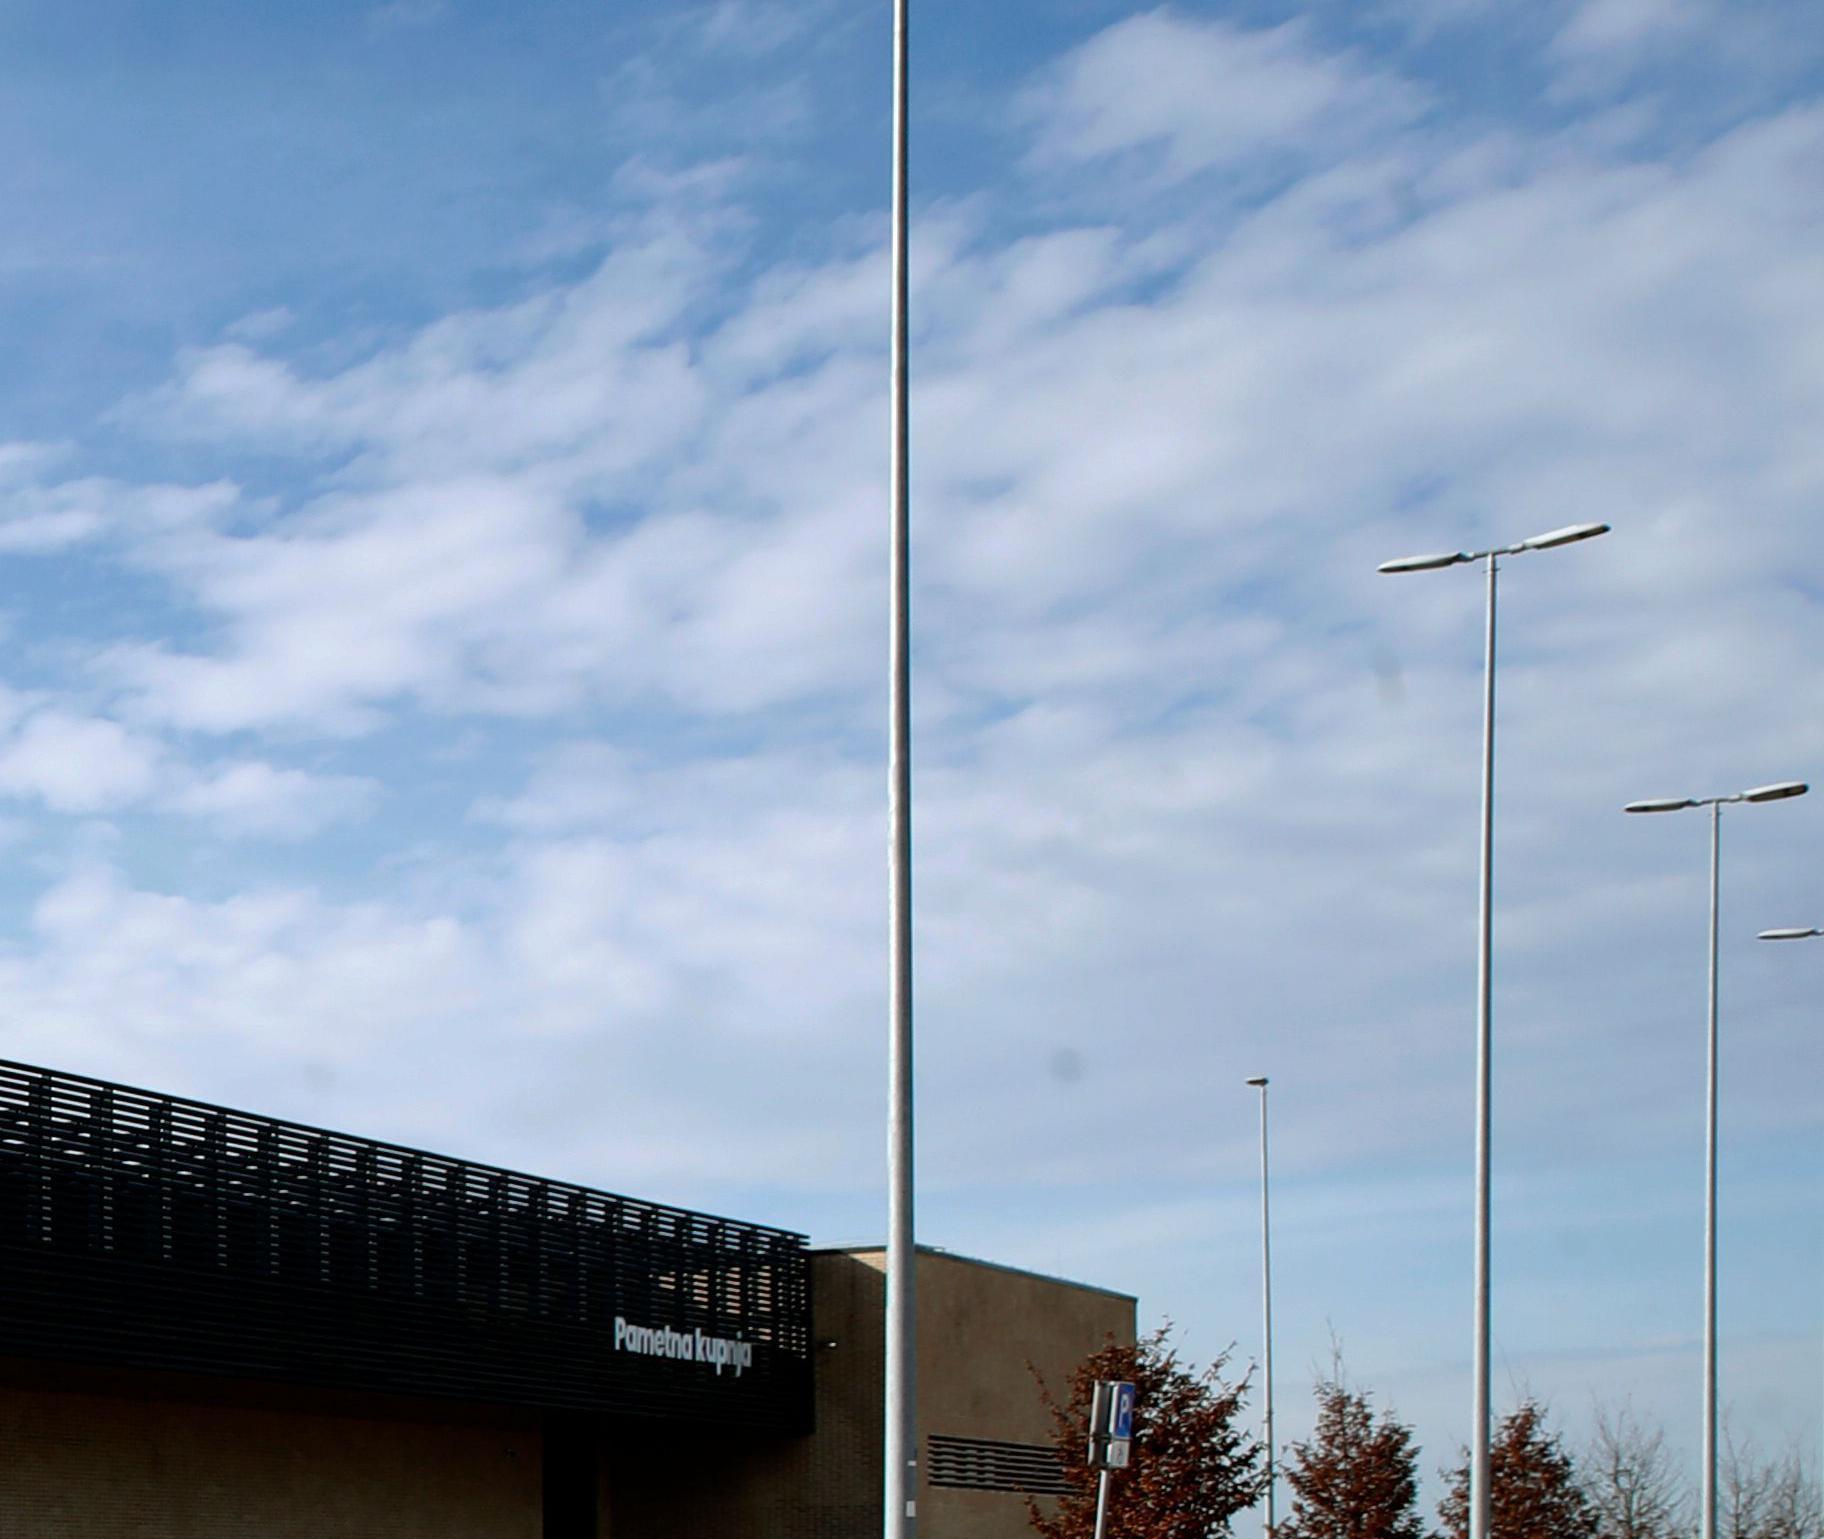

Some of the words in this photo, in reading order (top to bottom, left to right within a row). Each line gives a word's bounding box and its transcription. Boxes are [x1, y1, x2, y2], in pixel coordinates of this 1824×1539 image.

[614, 1316, 693, 1360] Pametna
[694, 1327, 752, 1377] kupnja
[1118, 1393, 1130, 1429] P
